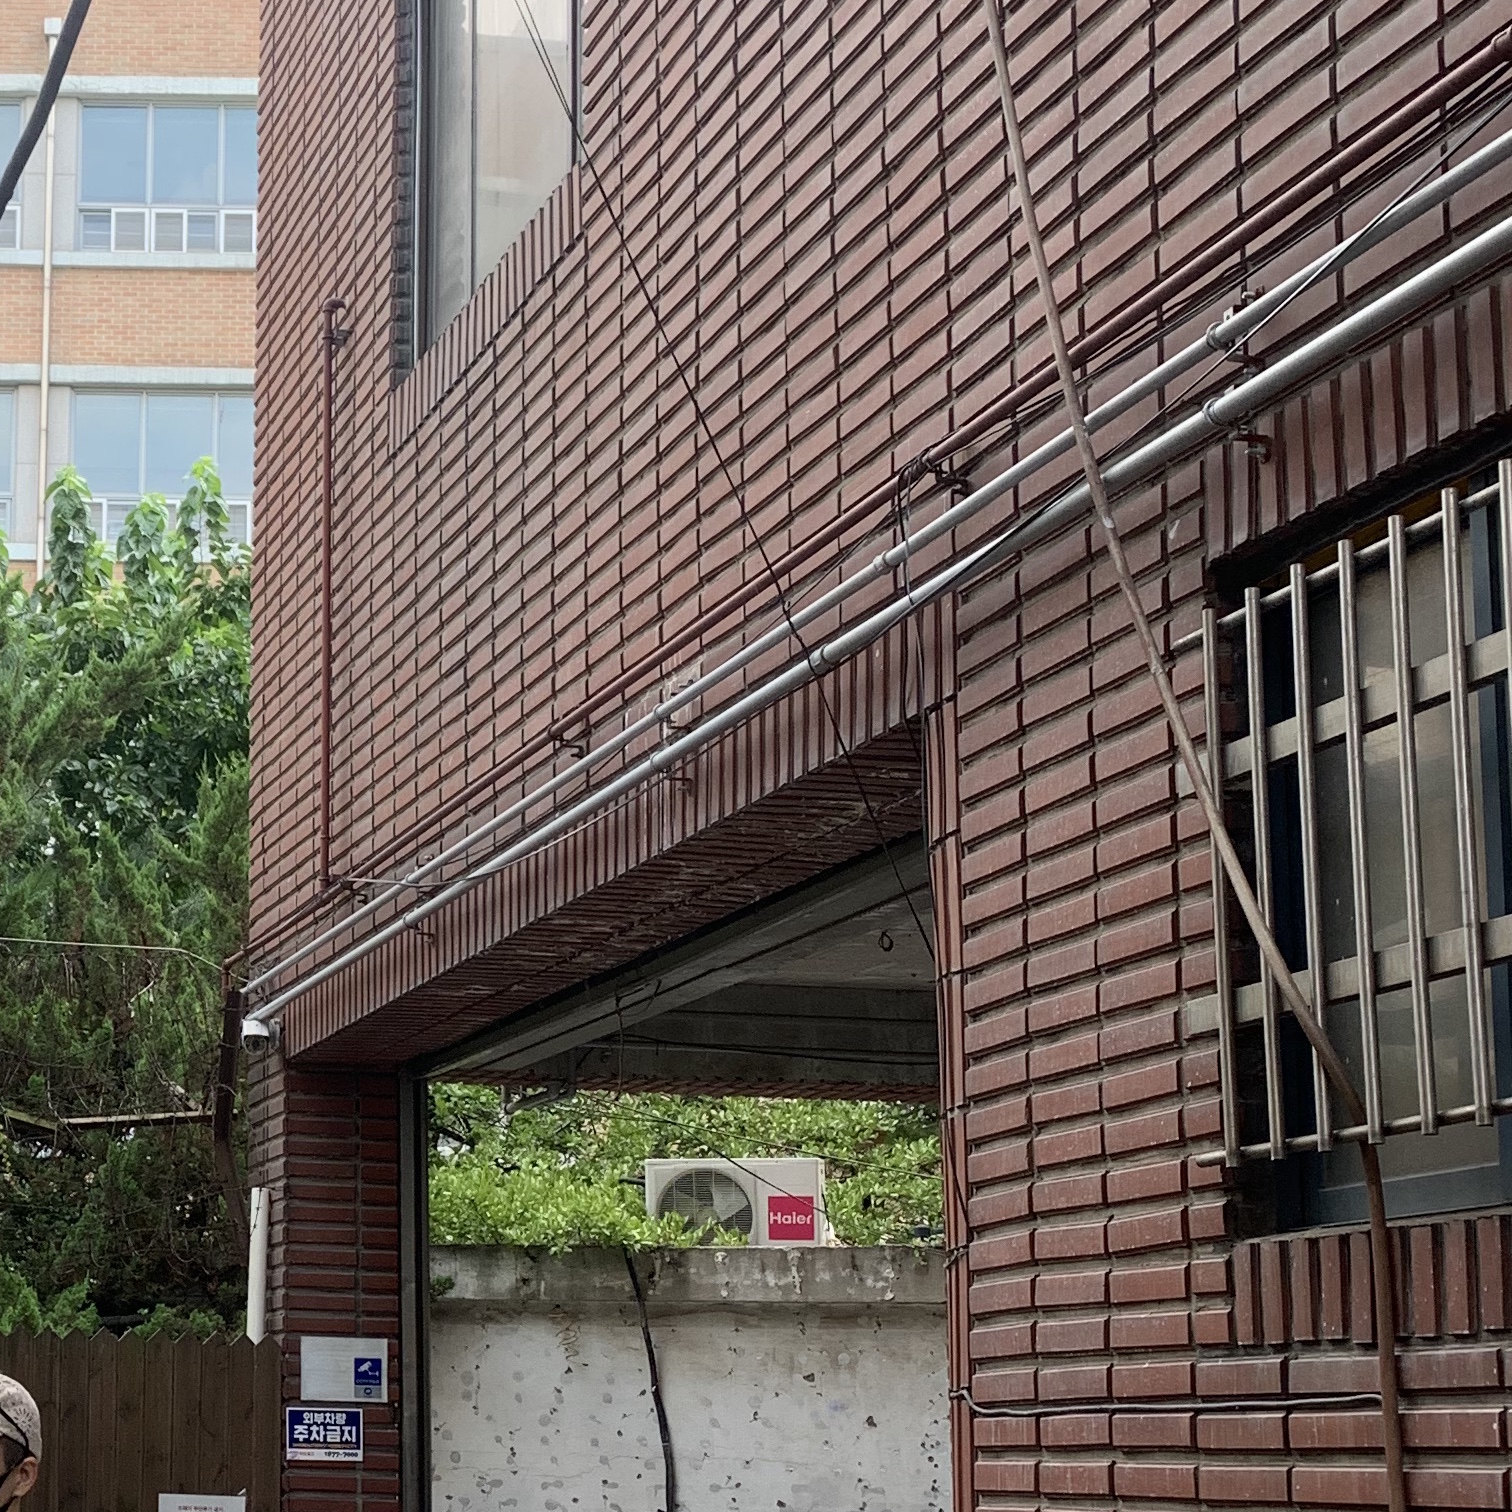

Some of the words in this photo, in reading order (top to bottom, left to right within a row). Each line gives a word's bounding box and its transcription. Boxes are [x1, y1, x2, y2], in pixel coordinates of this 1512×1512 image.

[769, 1211, 812, 1224] Haier
[302, 1411, 346, 1425] 외부차량
[293, 1424, 357, 1443] 주차금지
